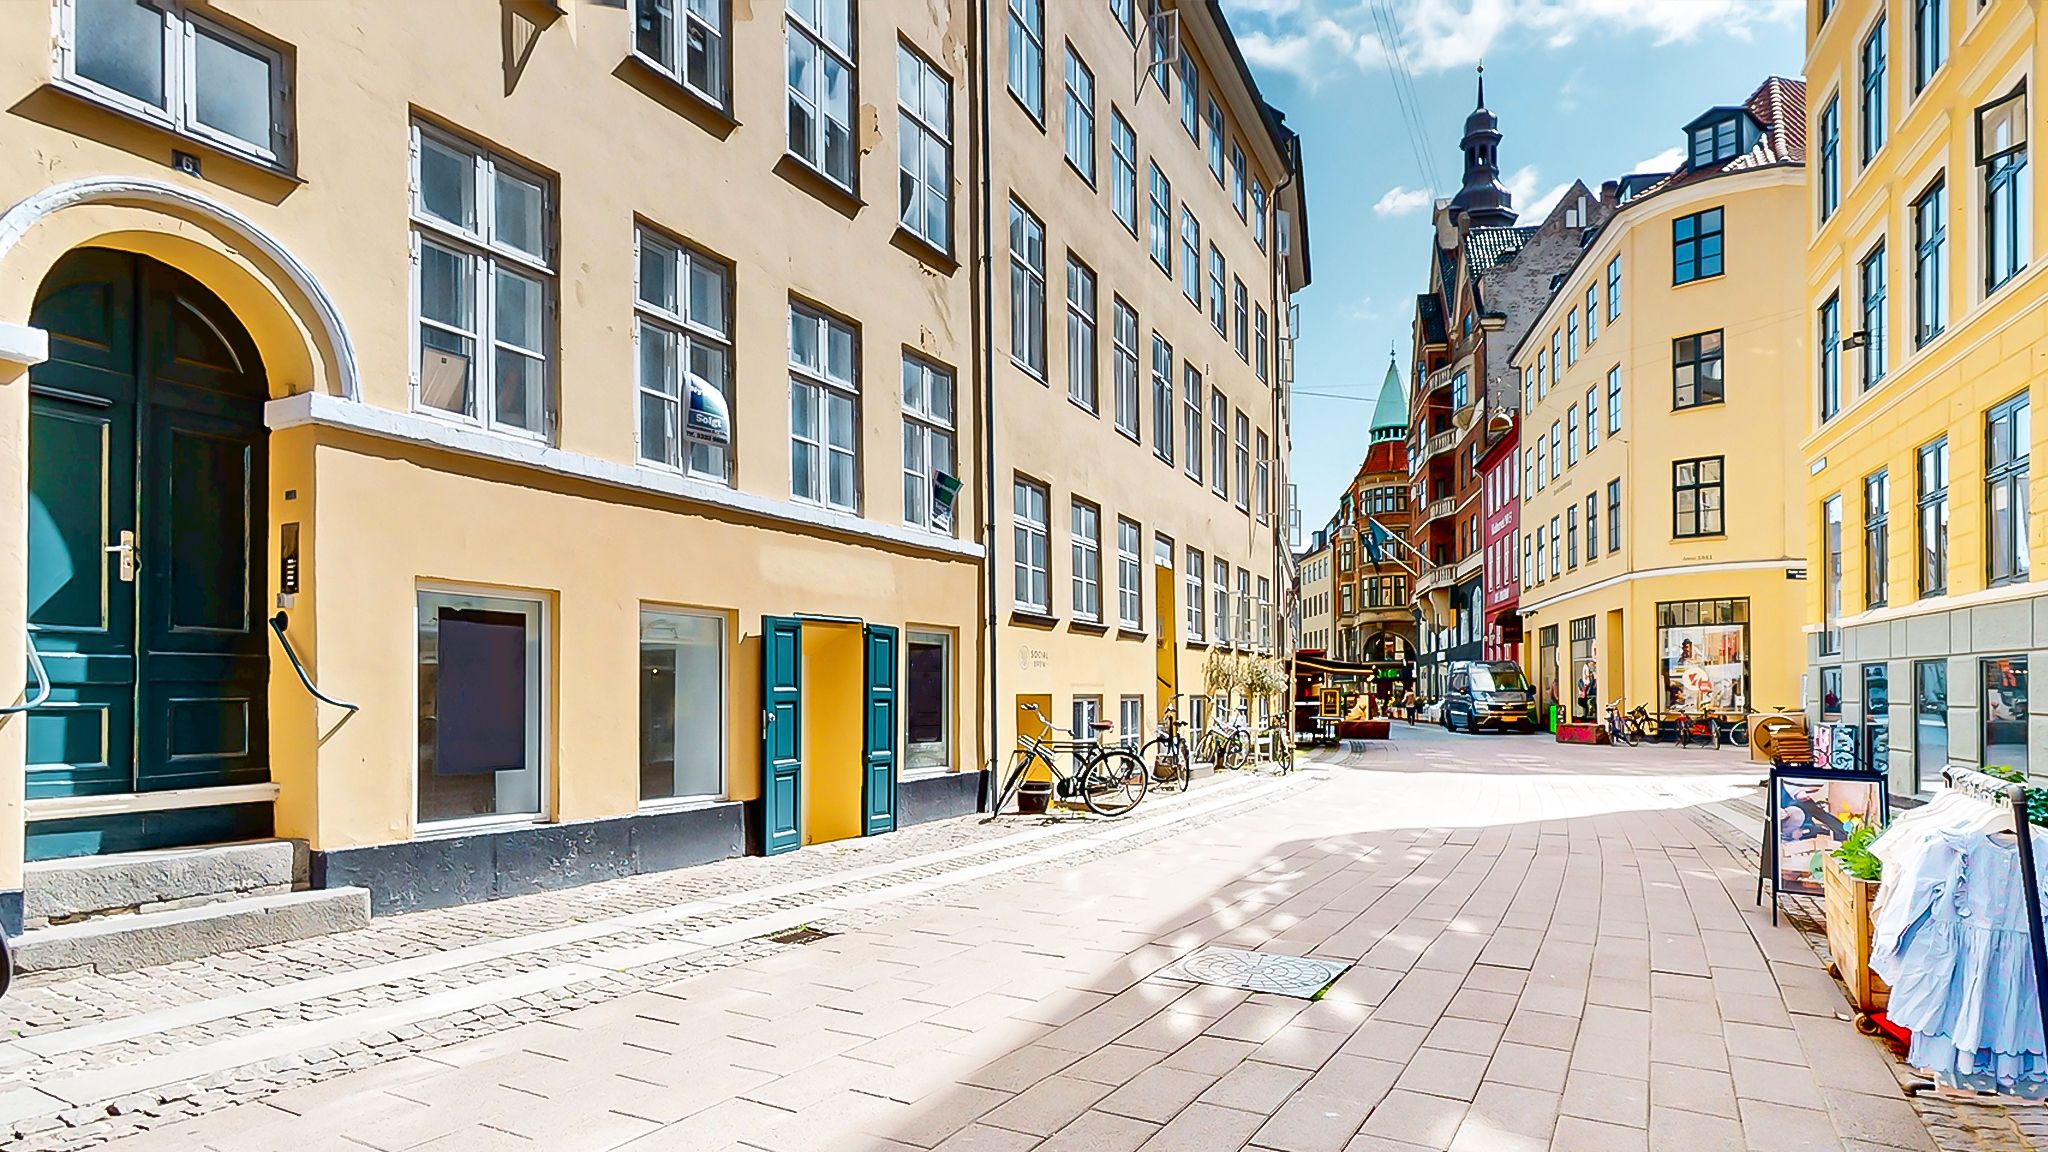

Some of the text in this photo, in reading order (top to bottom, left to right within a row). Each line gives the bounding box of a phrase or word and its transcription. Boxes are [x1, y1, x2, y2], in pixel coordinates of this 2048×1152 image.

[183, 156, 192, 171] 6
[696, 413, 722, 428] Solgt
[1030, 649, 1048, 659] SOCIAL
